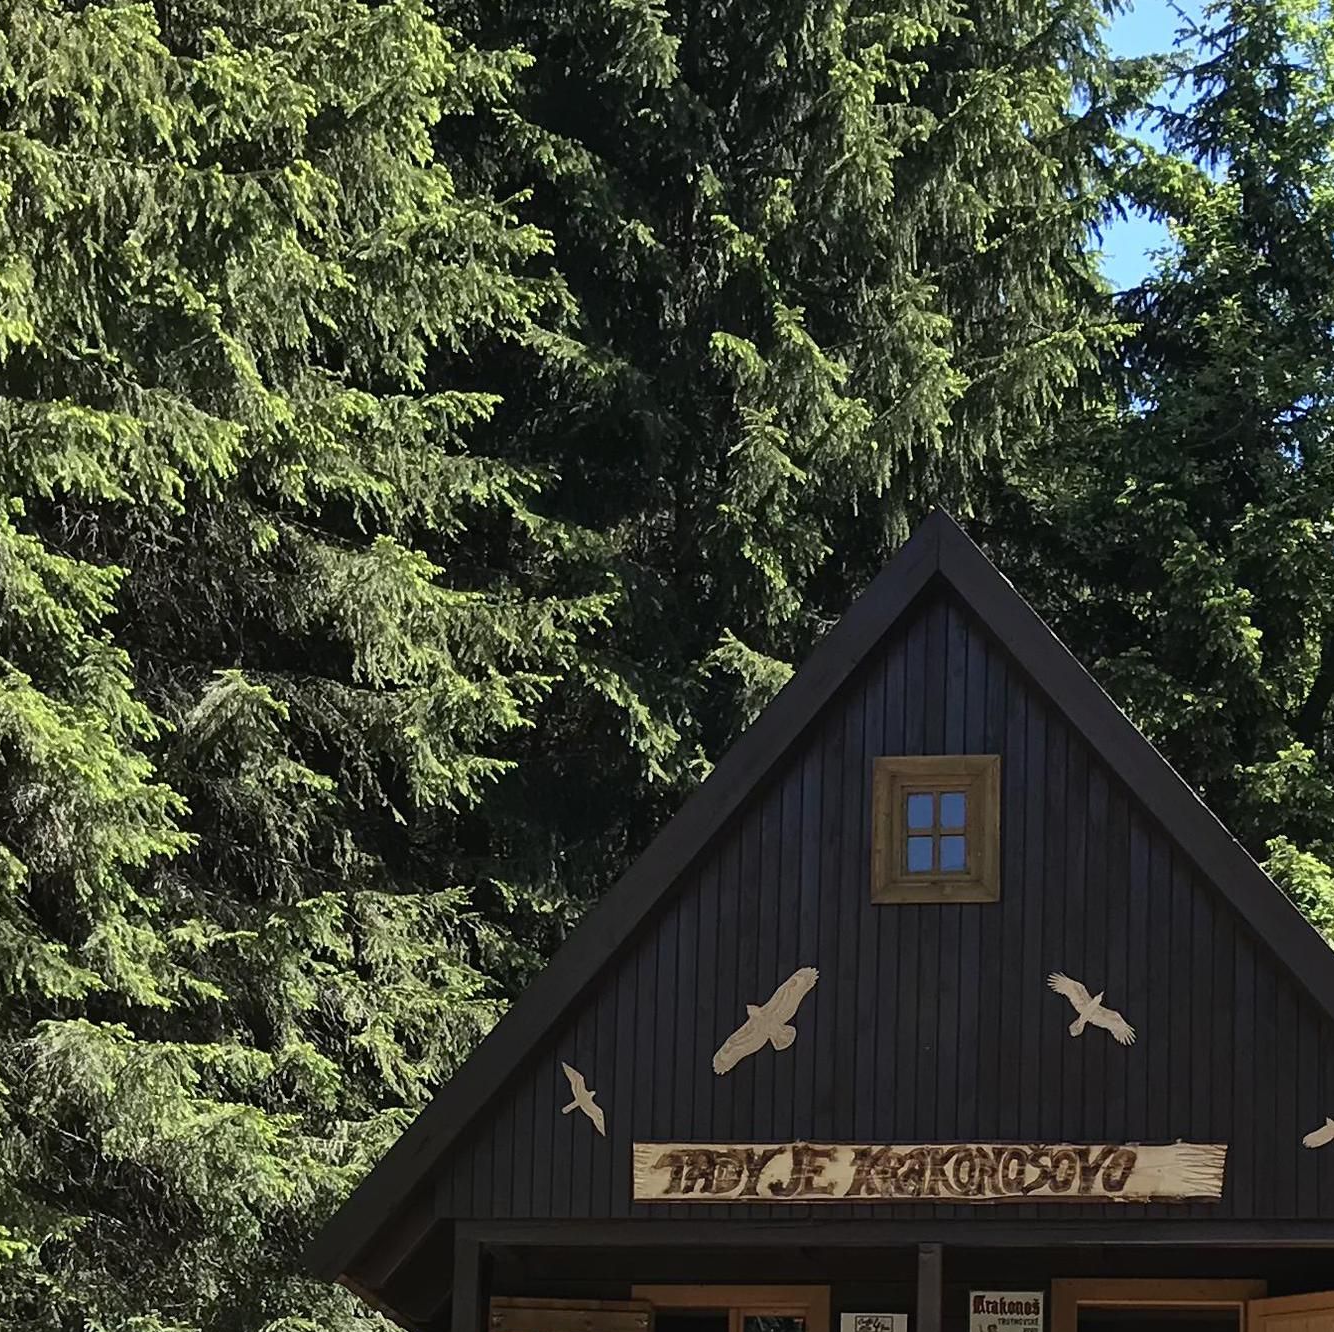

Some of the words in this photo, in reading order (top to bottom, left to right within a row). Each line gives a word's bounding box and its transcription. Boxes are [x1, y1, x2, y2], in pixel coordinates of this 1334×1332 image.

[651, 1146, 787, 1197] TADY
[768, 1145, 837, 1197] JE
[973, 1295, 1041, 1316] Krakonoš
